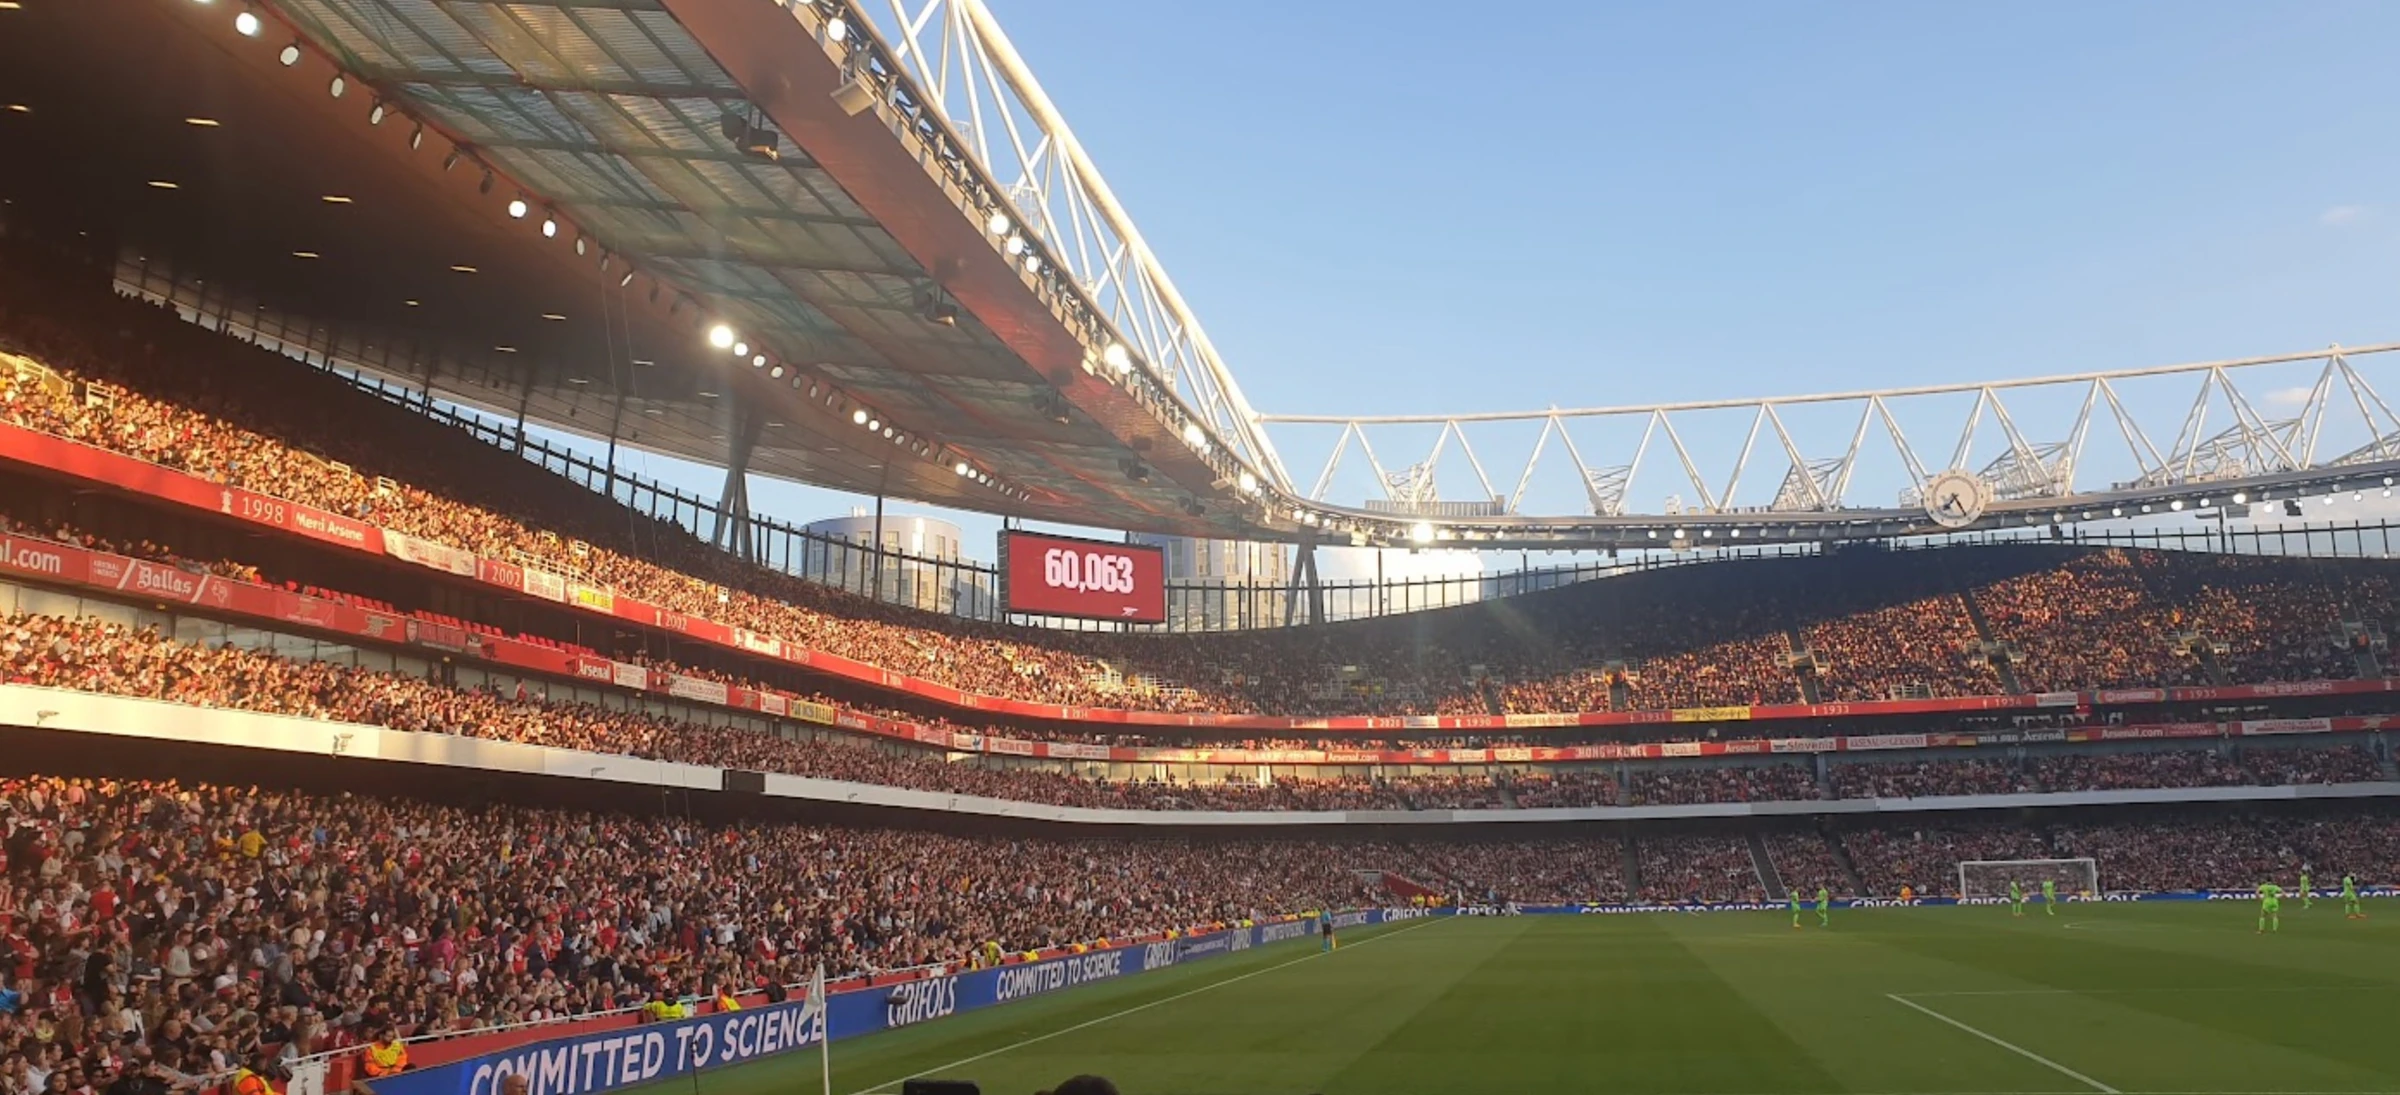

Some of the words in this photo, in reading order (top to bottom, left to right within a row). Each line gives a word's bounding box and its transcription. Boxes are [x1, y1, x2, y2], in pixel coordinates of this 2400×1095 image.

[242, 496, 284, 525] 1998
[295, 511, 325, 533] Merci
[137, 561, 192, 595] Dallas
[491, 566, 522, 588] 2002
[1044, 548, 1134, 594] 60,063
[580, 659, 611, 680] Arsenal
[2102, 728, 2164, 739] Arsenal.com
[1330, 751, 1380, 762] Arsenal.com
[1725, 742, 1760, 753] Arsenal
[1382, 906, 1430, 922] GRIFOLS
[1144, 940, 1176, 971] GRIFOLS
[996, 960, 1065, 1001] COMMITTED
[1067, 957, 1082, 985] TO
[1082, 950, 1122, 982] SCIENCE
[470, 1035, 665, 1095] COMMITTED
[676, 1023, 714, 1072] TO
